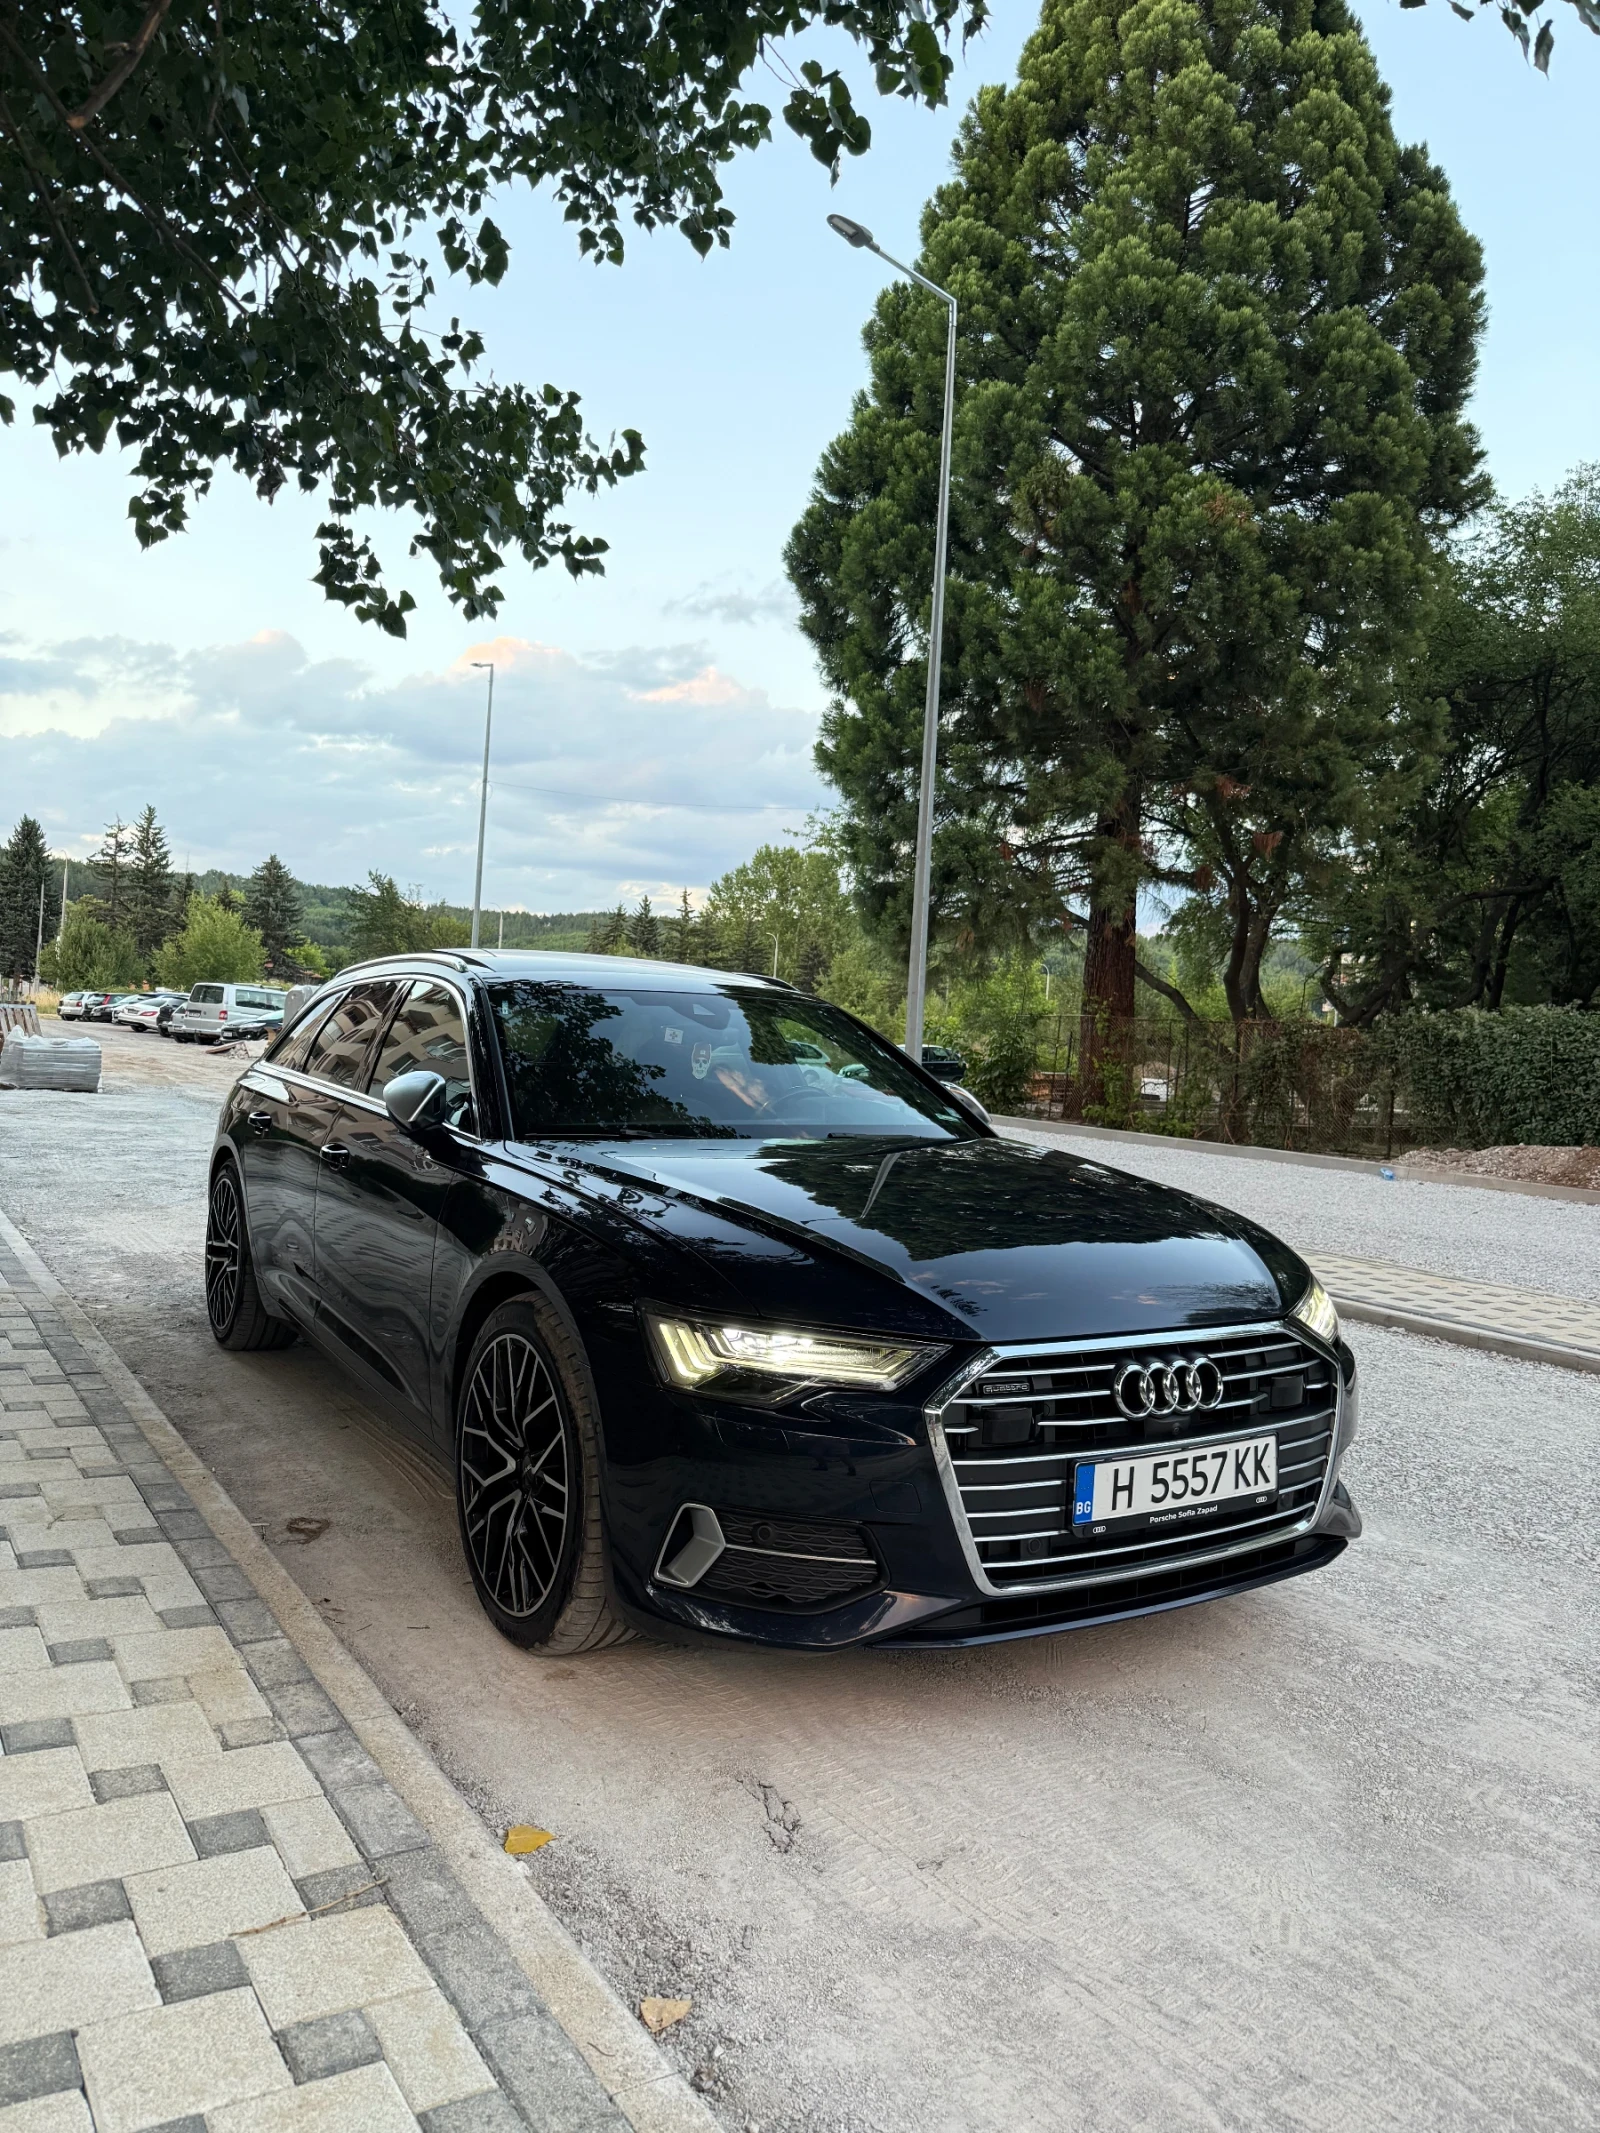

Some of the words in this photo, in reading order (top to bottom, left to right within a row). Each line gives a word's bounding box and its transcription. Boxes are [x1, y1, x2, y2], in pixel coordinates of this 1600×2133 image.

[984, 1384, 1029, 1393] quattro
[1111, 1466, 1135, 1511] H
[1076, 1501, 1092, 1515] BG
[1149, 1513, 1177, 1524] Porsche
[1178, 1509, 1196, 1518] Sofia
[1196, 1504, 1218, 1515] Zapad
